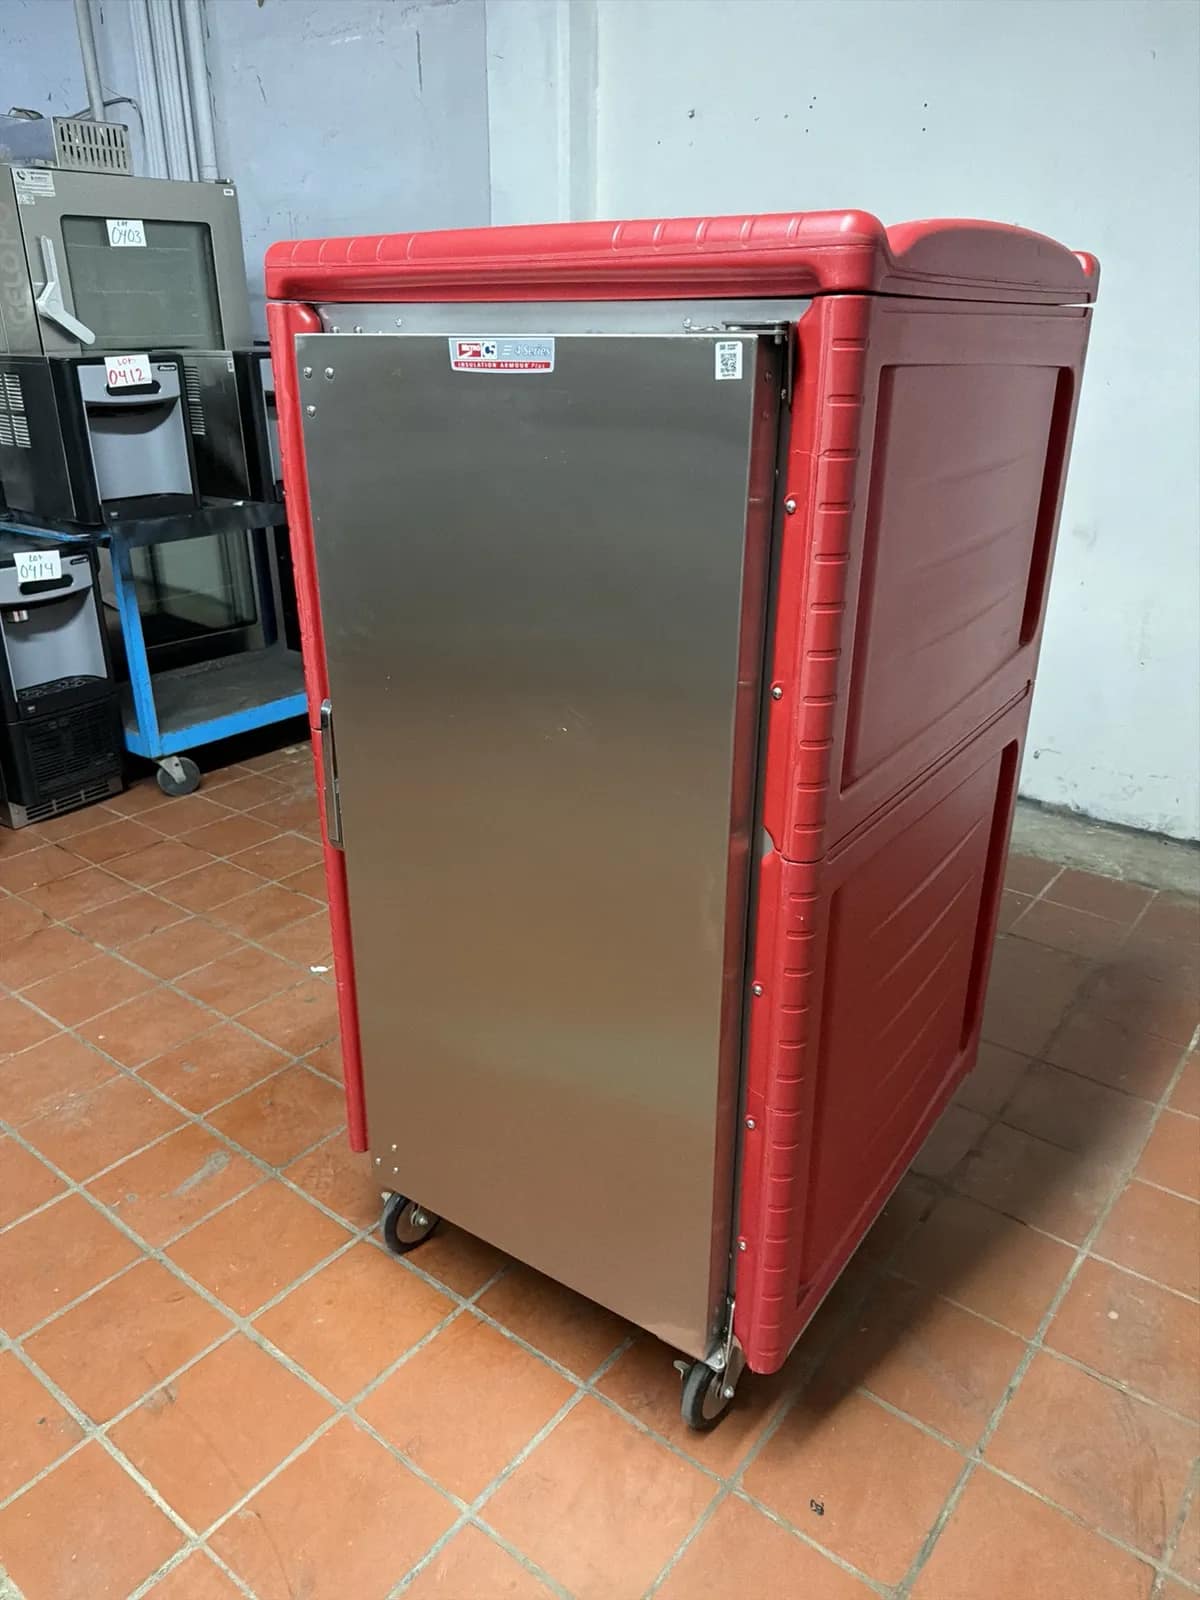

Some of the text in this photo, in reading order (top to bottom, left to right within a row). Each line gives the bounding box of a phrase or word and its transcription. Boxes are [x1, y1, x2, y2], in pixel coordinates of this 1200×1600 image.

[111, 226, 142, 245] 0403
[523, 343, 551, 356] Series
[109, 367, 144, 385] 0412
[20, 562, 54, 579] 0414
